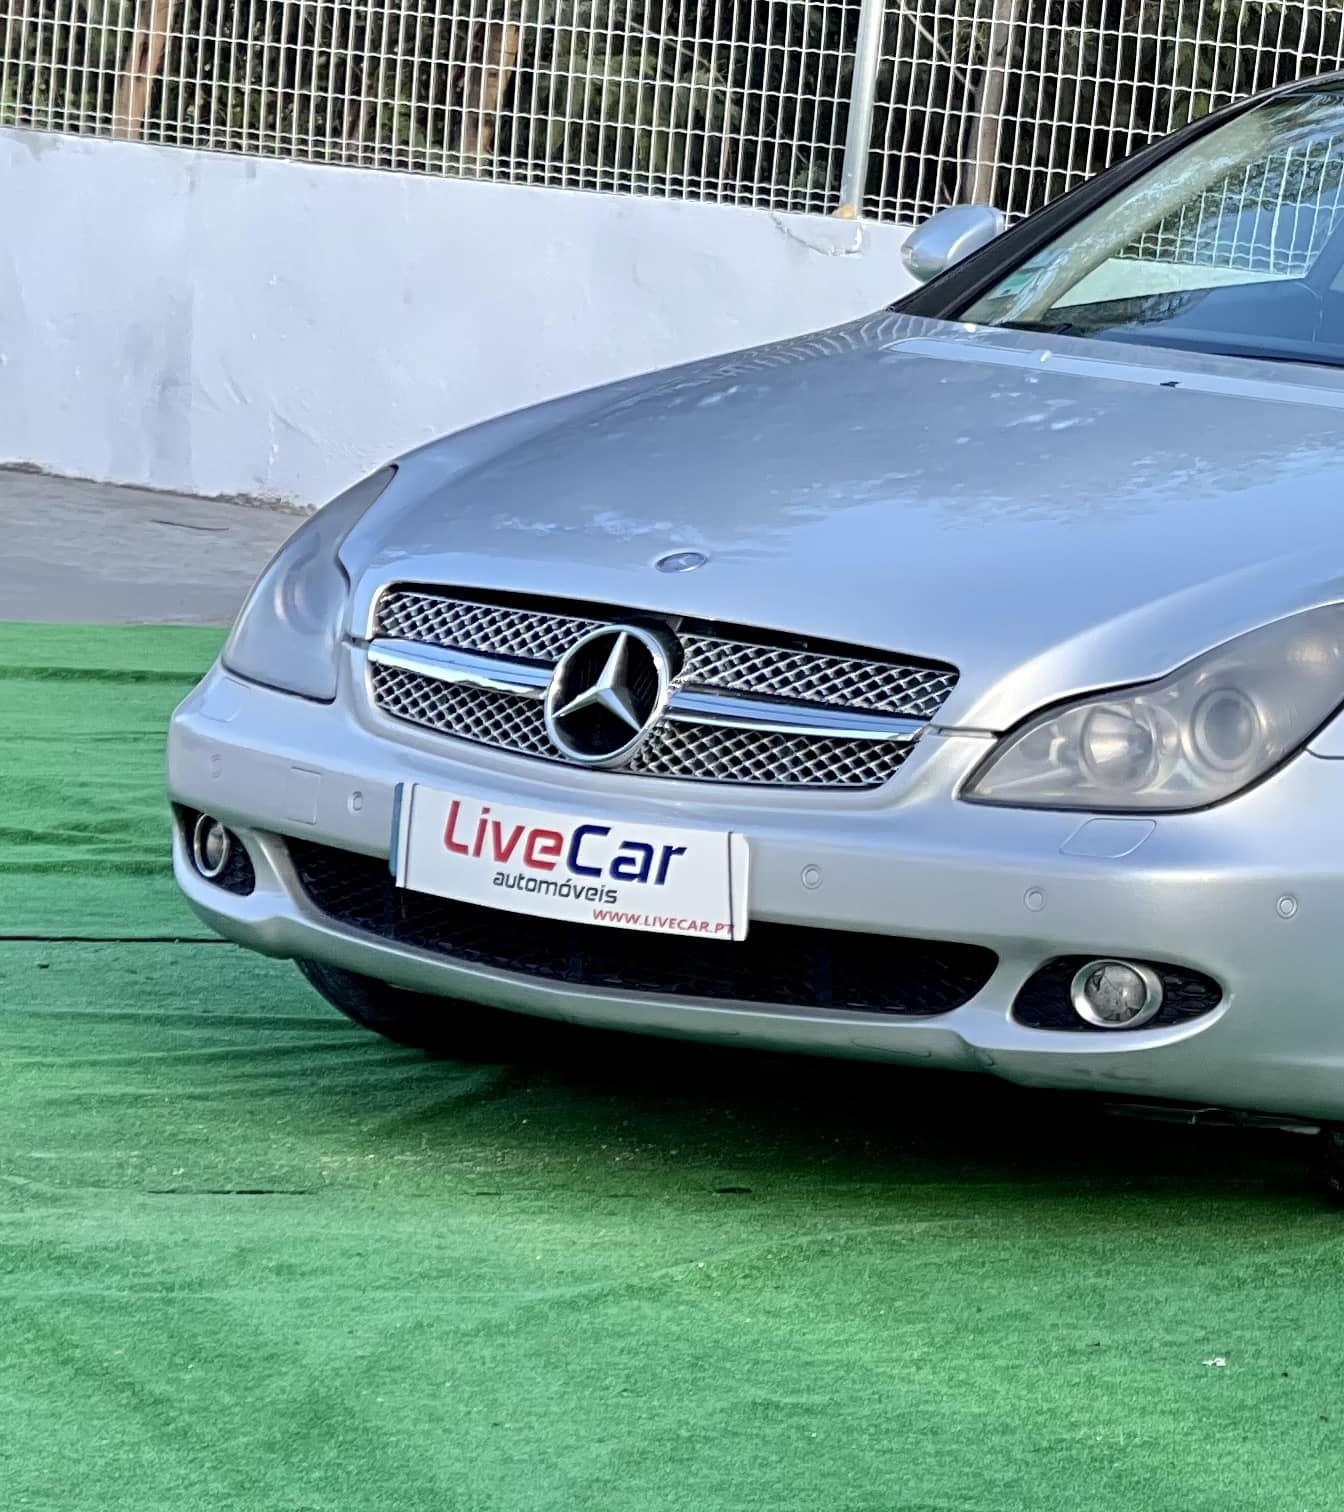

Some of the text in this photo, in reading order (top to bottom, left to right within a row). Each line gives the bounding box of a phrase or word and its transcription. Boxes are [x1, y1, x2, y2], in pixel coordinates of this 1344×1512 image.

[443, 799, 687, 886] LiveCar
[493, 870, 618, 904] automóveis
[593, 909, 735, 935] WWW.LIVECAR.PT
